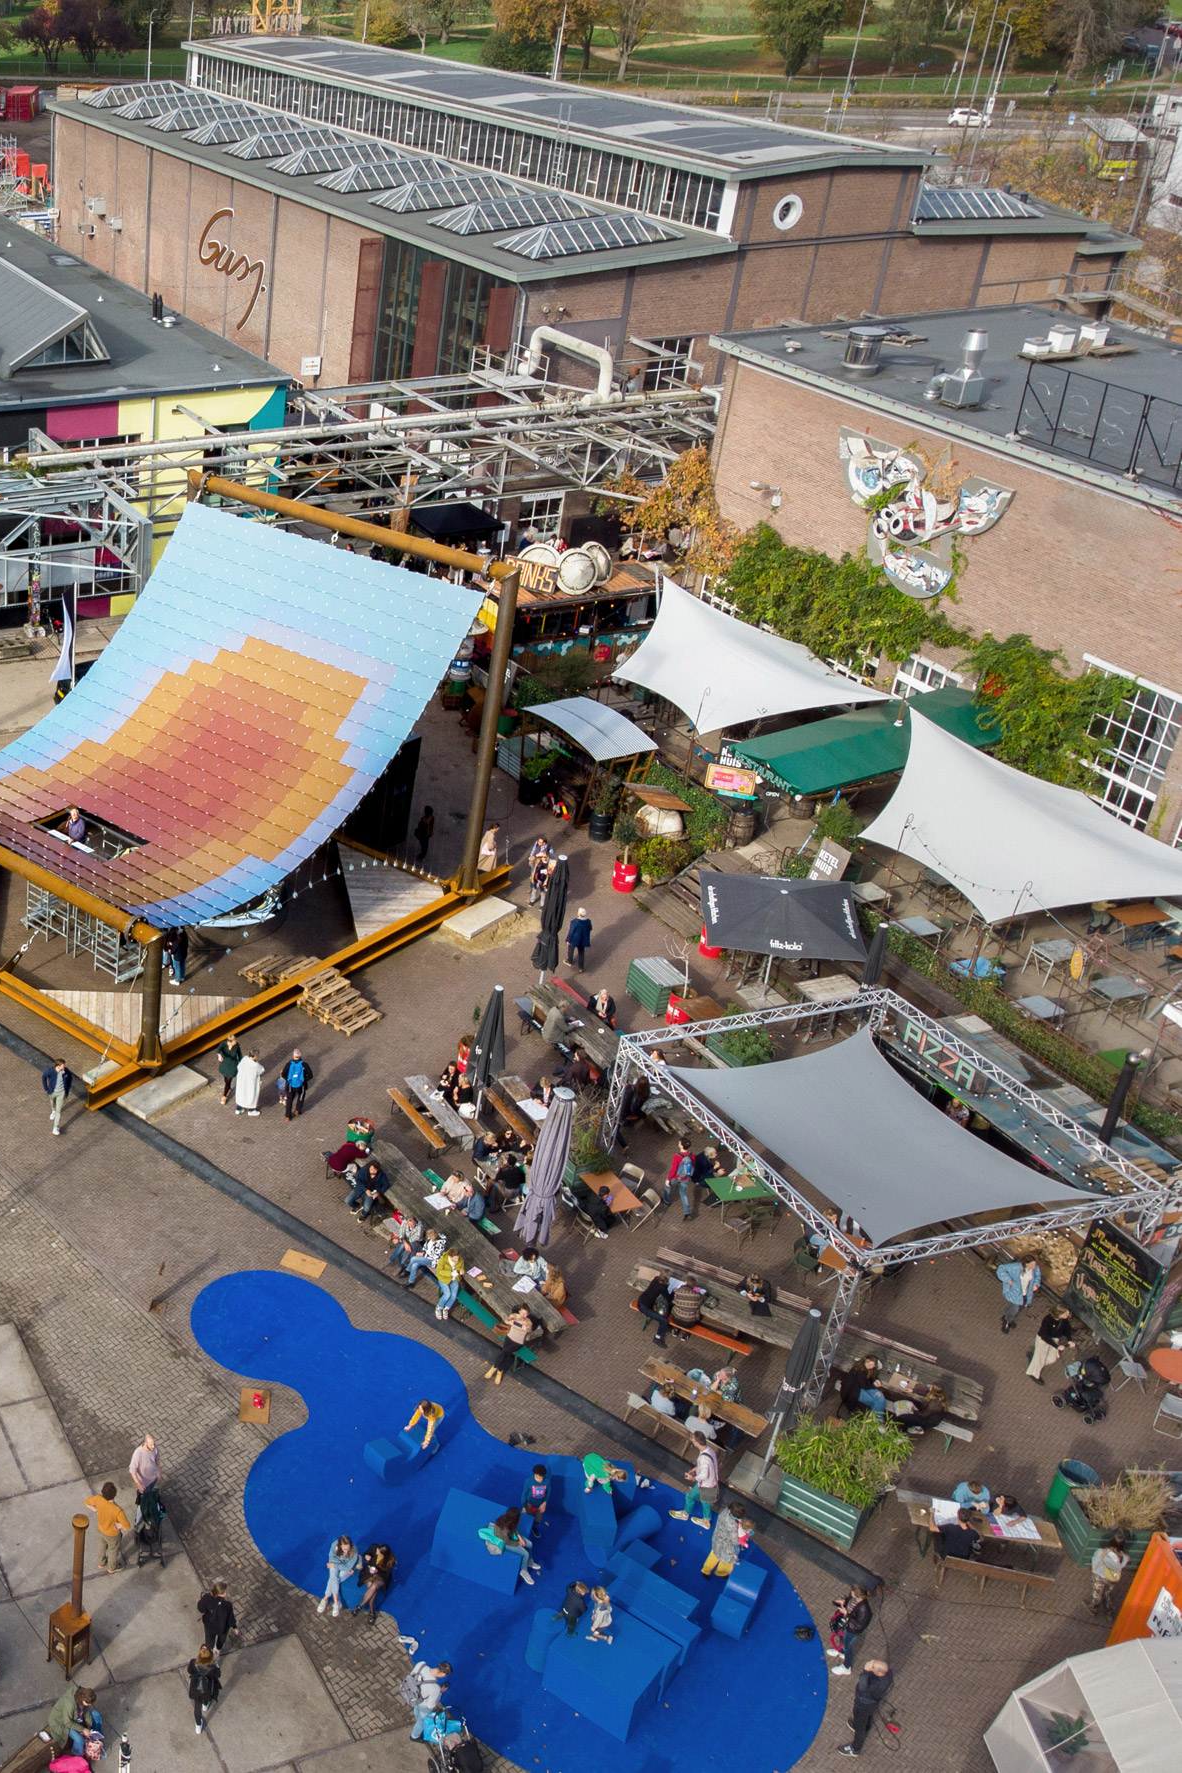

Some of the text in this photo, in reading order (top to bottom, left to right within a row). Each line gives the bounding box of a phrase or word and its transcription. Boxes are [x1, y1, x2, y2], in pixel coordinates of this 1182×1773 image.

[719, 756, 742, 768] HUIS
[735, 750, 792, 793] RESTAURANT
[814, 857, 833, 876] HUIS
[818, 848, 840, 869] KETEL
[903, 1020, 976, 1090] PIZZA
